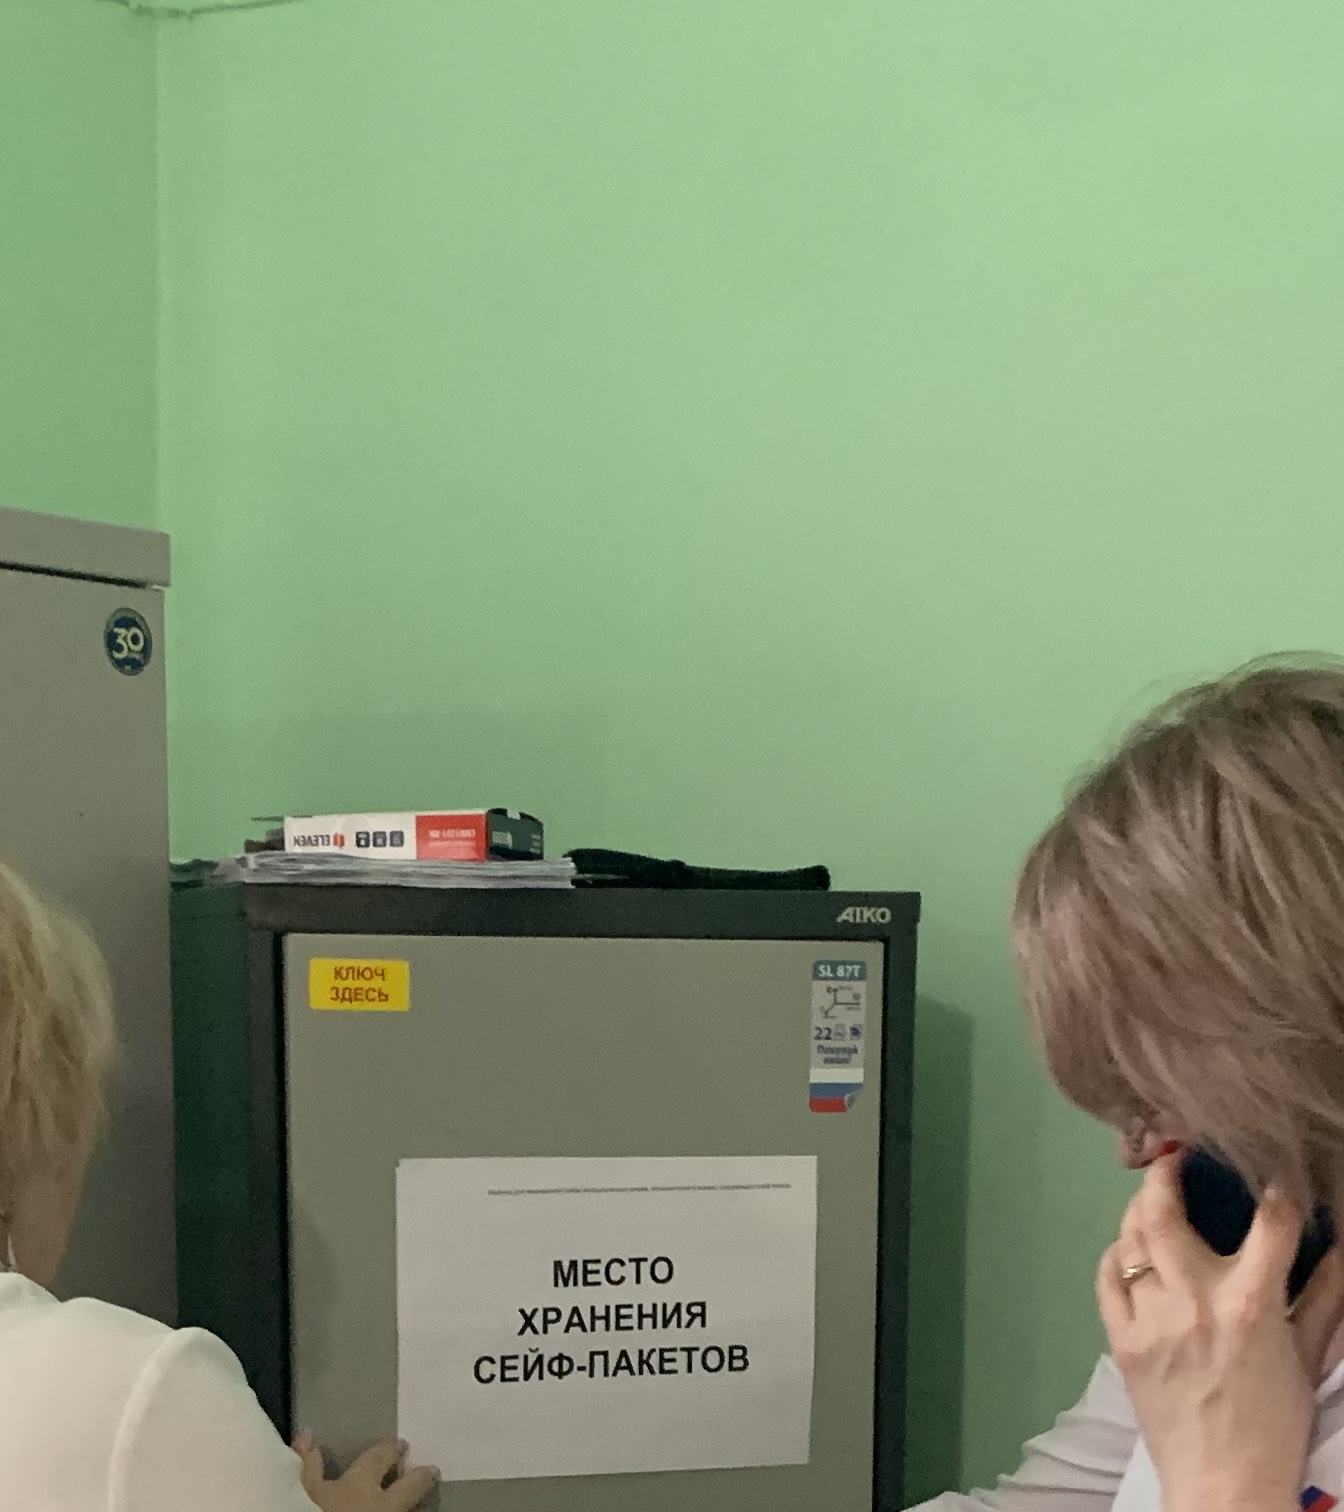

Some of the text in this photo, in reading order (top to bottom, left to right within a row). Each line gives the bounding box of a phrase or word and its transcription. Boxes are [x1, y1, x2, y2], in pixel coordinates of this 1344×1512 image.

[112, 627, 144, 659] 30
[836, 906, 892, 923] AIKO
[333, 966, 386, 981] КЛЮЧ
[819, 964, 834, 977] SL
[330, 986, 389, 1004] ЗДЕСЬ
[553, 1256, 675, 1288] МЕСТО
[517, 1301, 707, 1336] ХРАНЕНИЯ
[473, 1345, 750, 1385] СЕЙФ-ПАКЕТОВ
